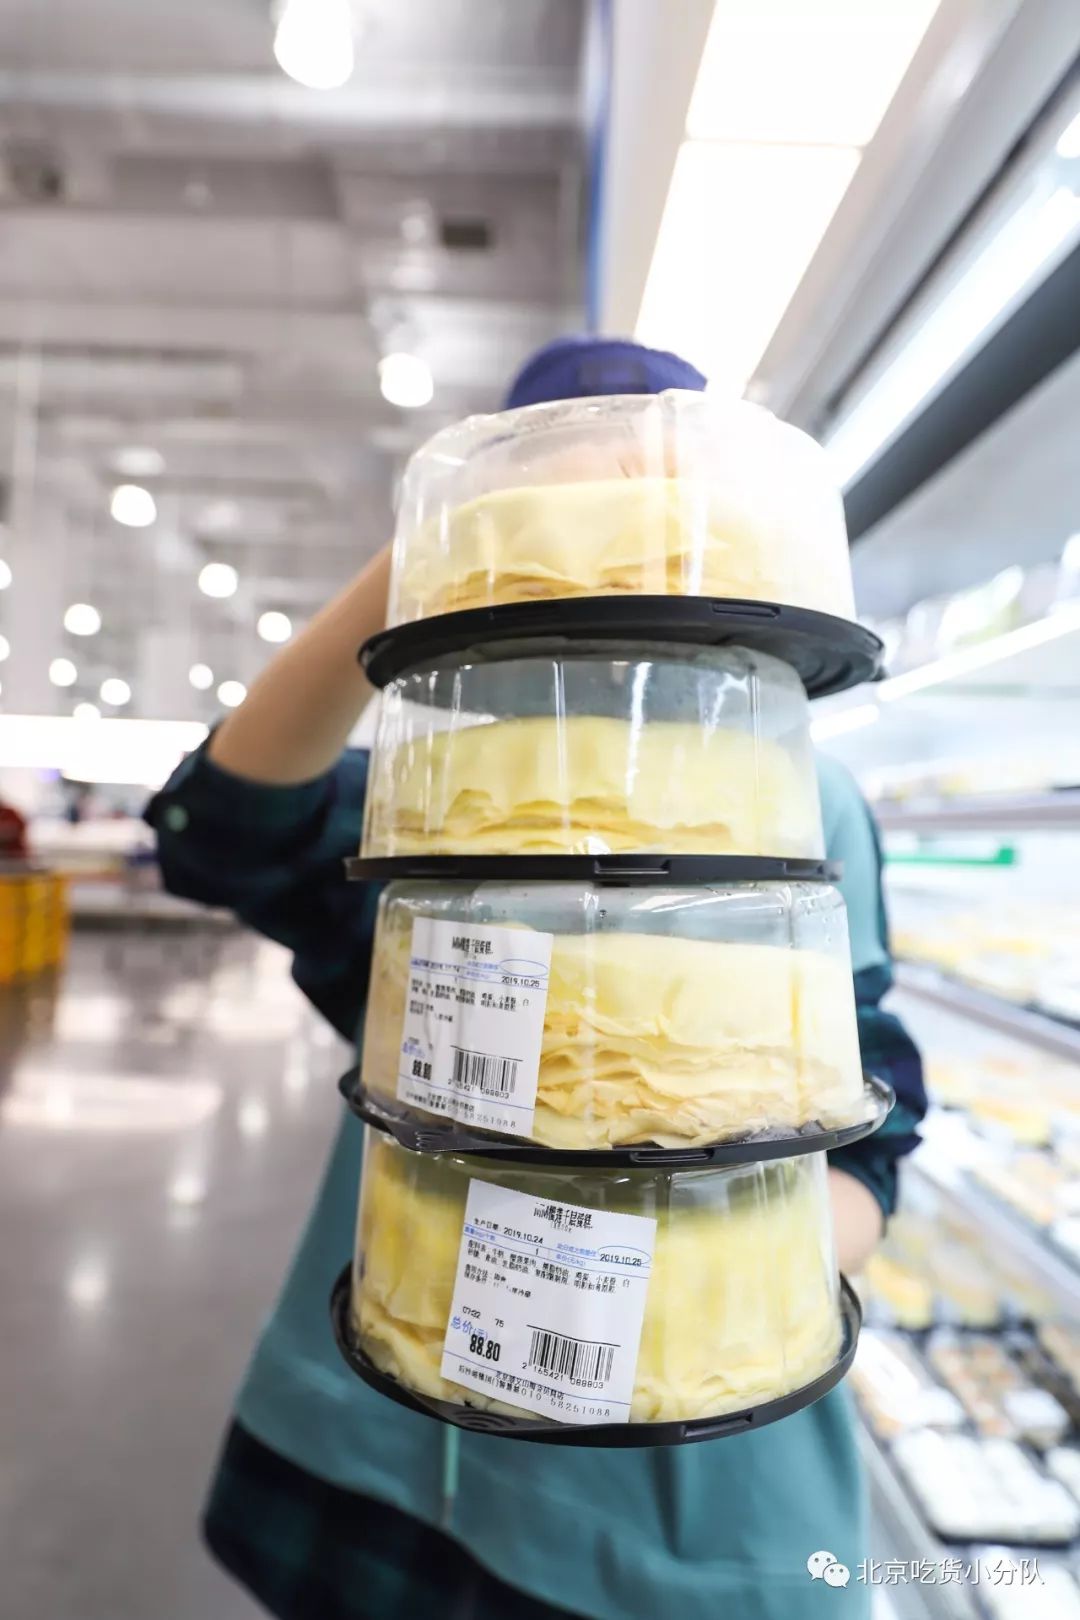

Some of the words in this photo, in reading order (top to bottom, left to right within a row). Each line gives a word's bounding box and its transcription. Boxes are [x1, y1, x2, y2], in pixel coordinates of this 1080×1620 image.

[501, 975, 540, 988] 2019.10.25
[503, 1226, 544, 1245] 2019.10.24
[599, 1252, 643, 1267] 2019.10.25
[494, 1317, 505, 1328] 75
[469, 1333, 502, 1362] 88.80
[521, 1362, 528, 1370] 2
[533, 1365, 565, 1382] 165421
[570, 1377, 604, 1390] 088803
